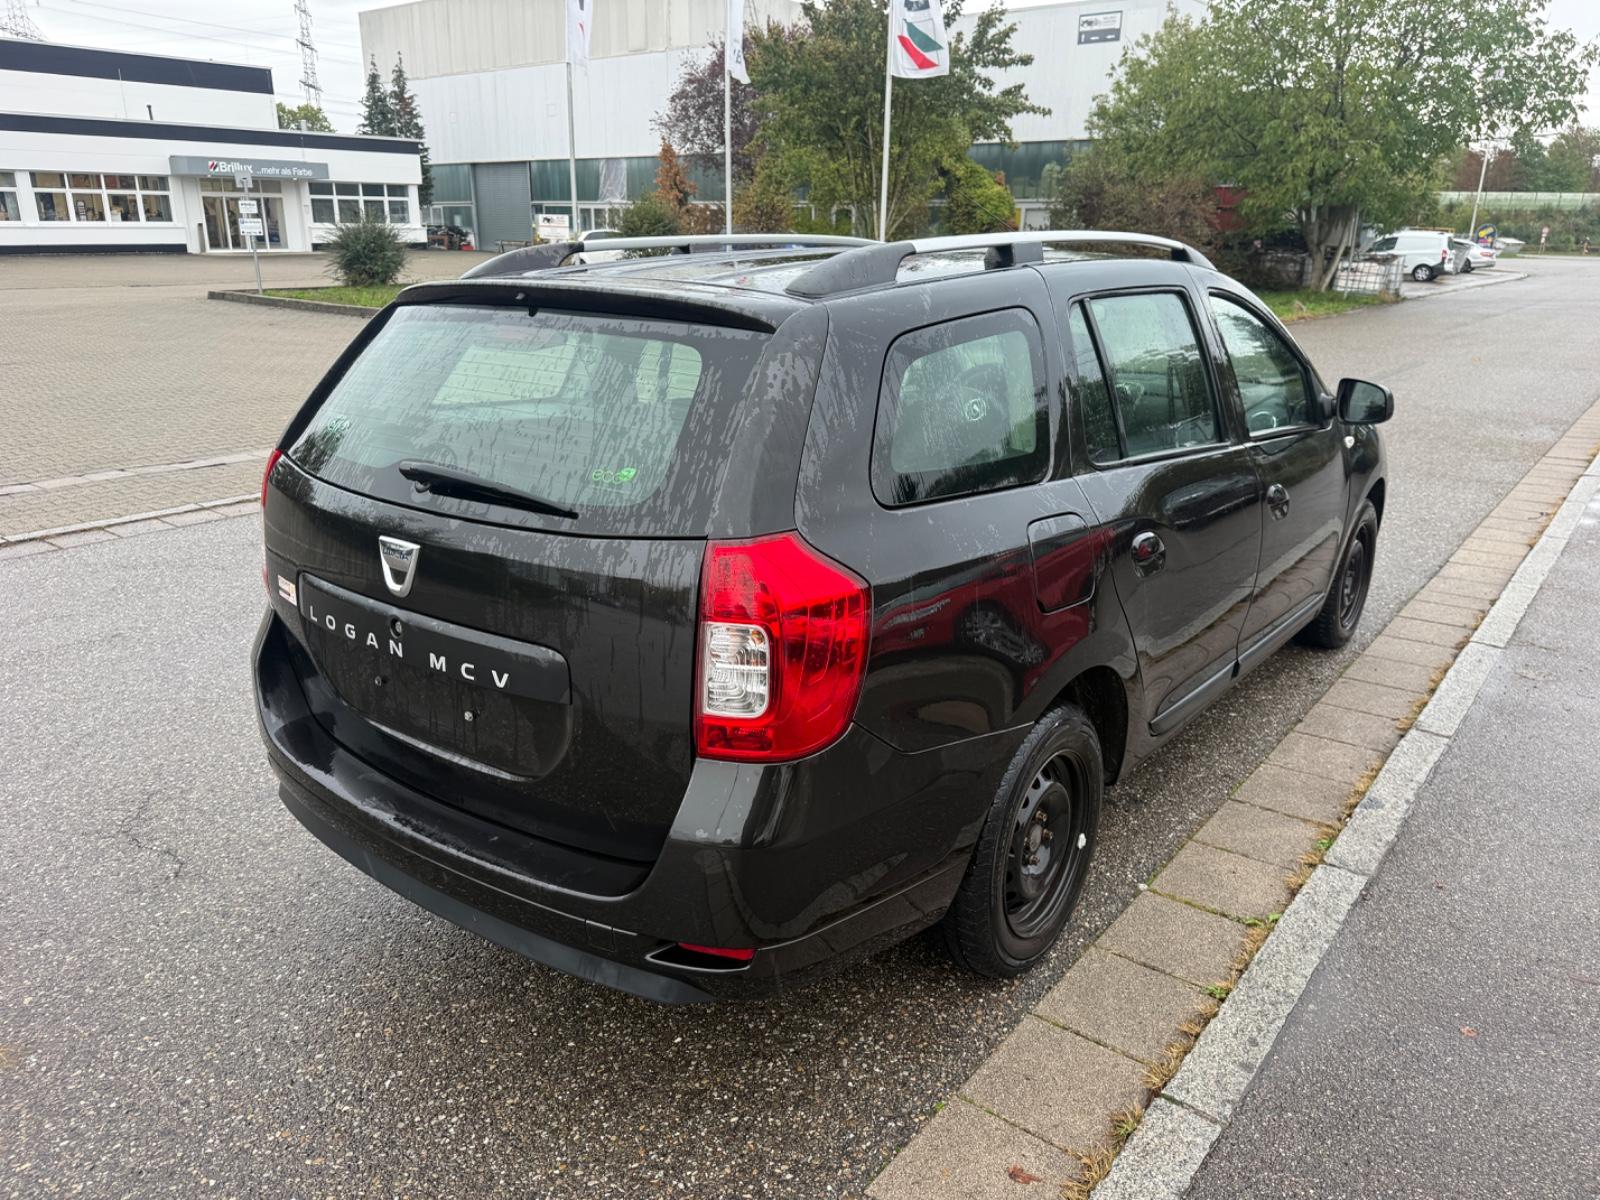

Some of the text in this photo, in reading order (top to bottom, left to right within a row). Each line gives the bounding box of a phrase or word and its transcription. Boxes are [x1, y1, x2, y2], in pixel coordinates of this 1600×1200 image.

[220, 161, 253, 174] Brillux
[281, 167, 292, 176] als
[293, 167, 312, 177] Farbe
[309, 606, 509, 689] LOGAN MCV
